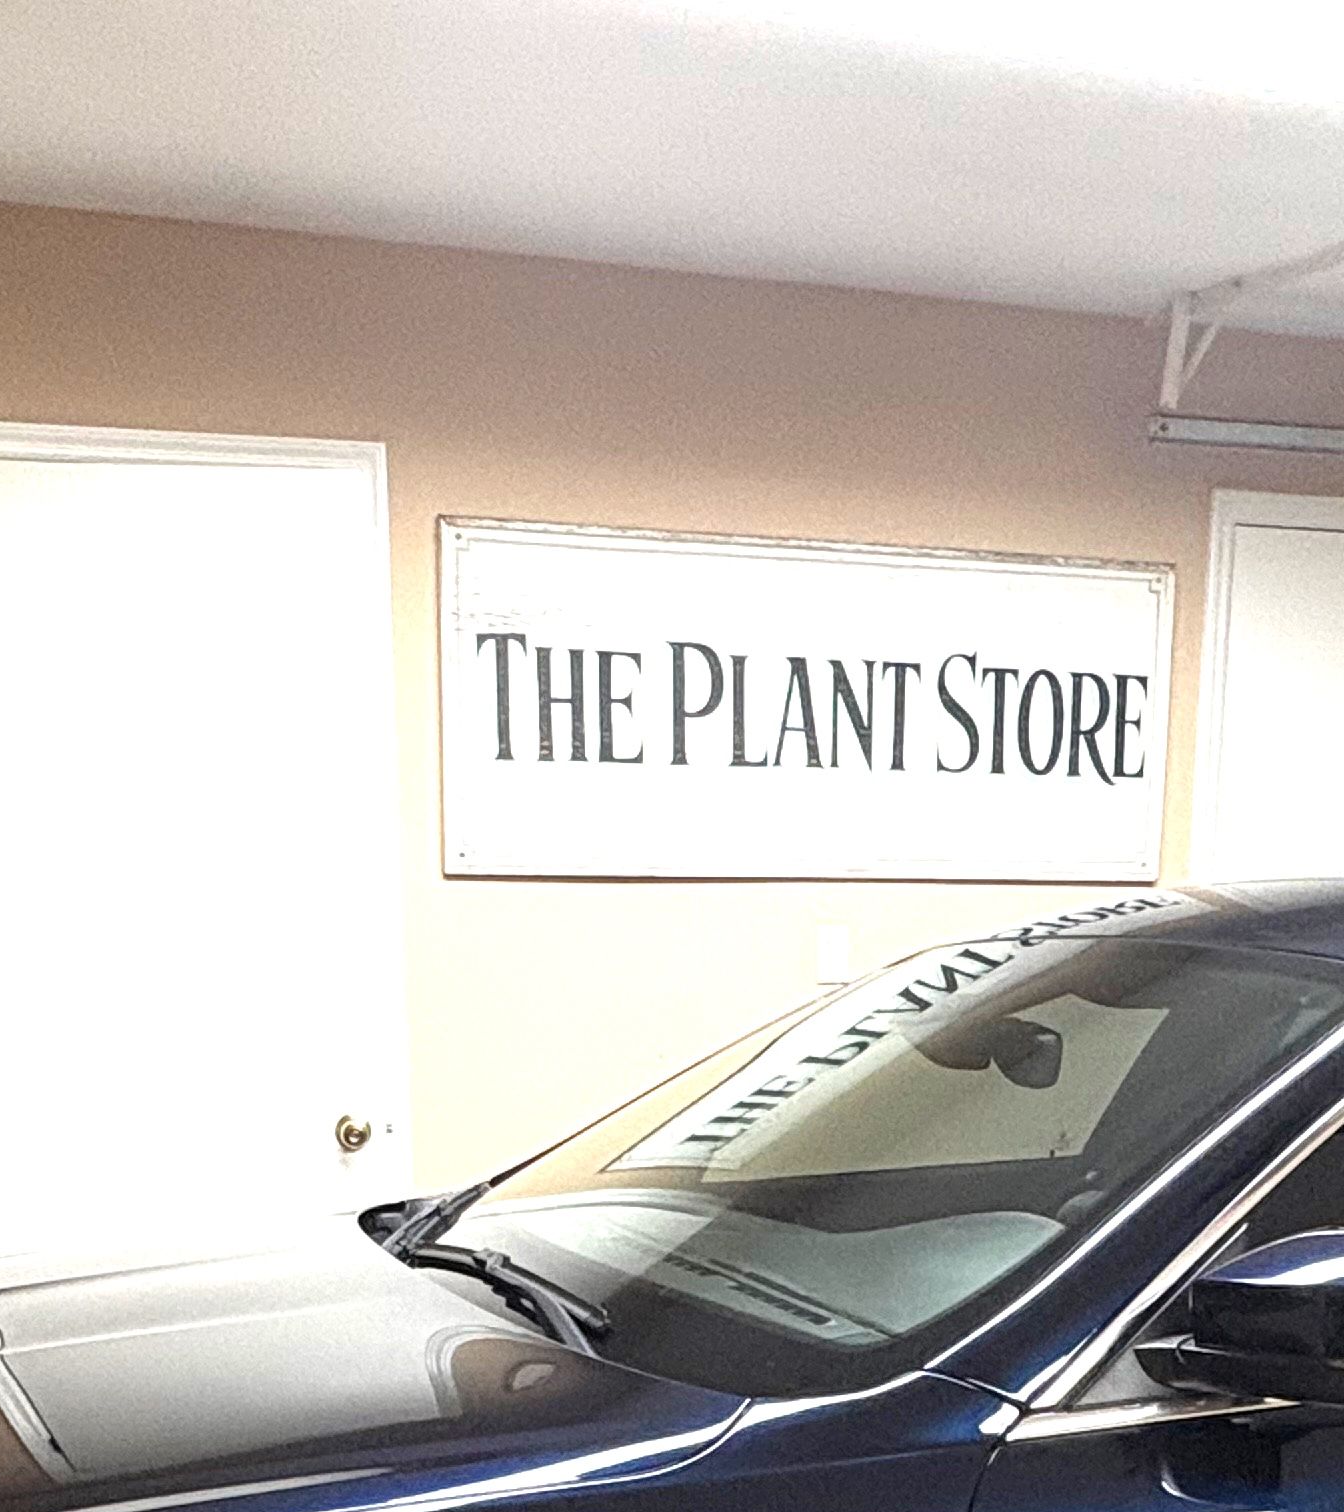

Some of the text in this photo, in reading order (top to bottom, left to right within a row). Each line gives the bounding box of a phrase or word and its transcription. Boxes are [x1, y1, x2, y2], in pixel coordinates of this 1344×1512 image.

[476, 632, 1149, 786] THE PLANT STORE
